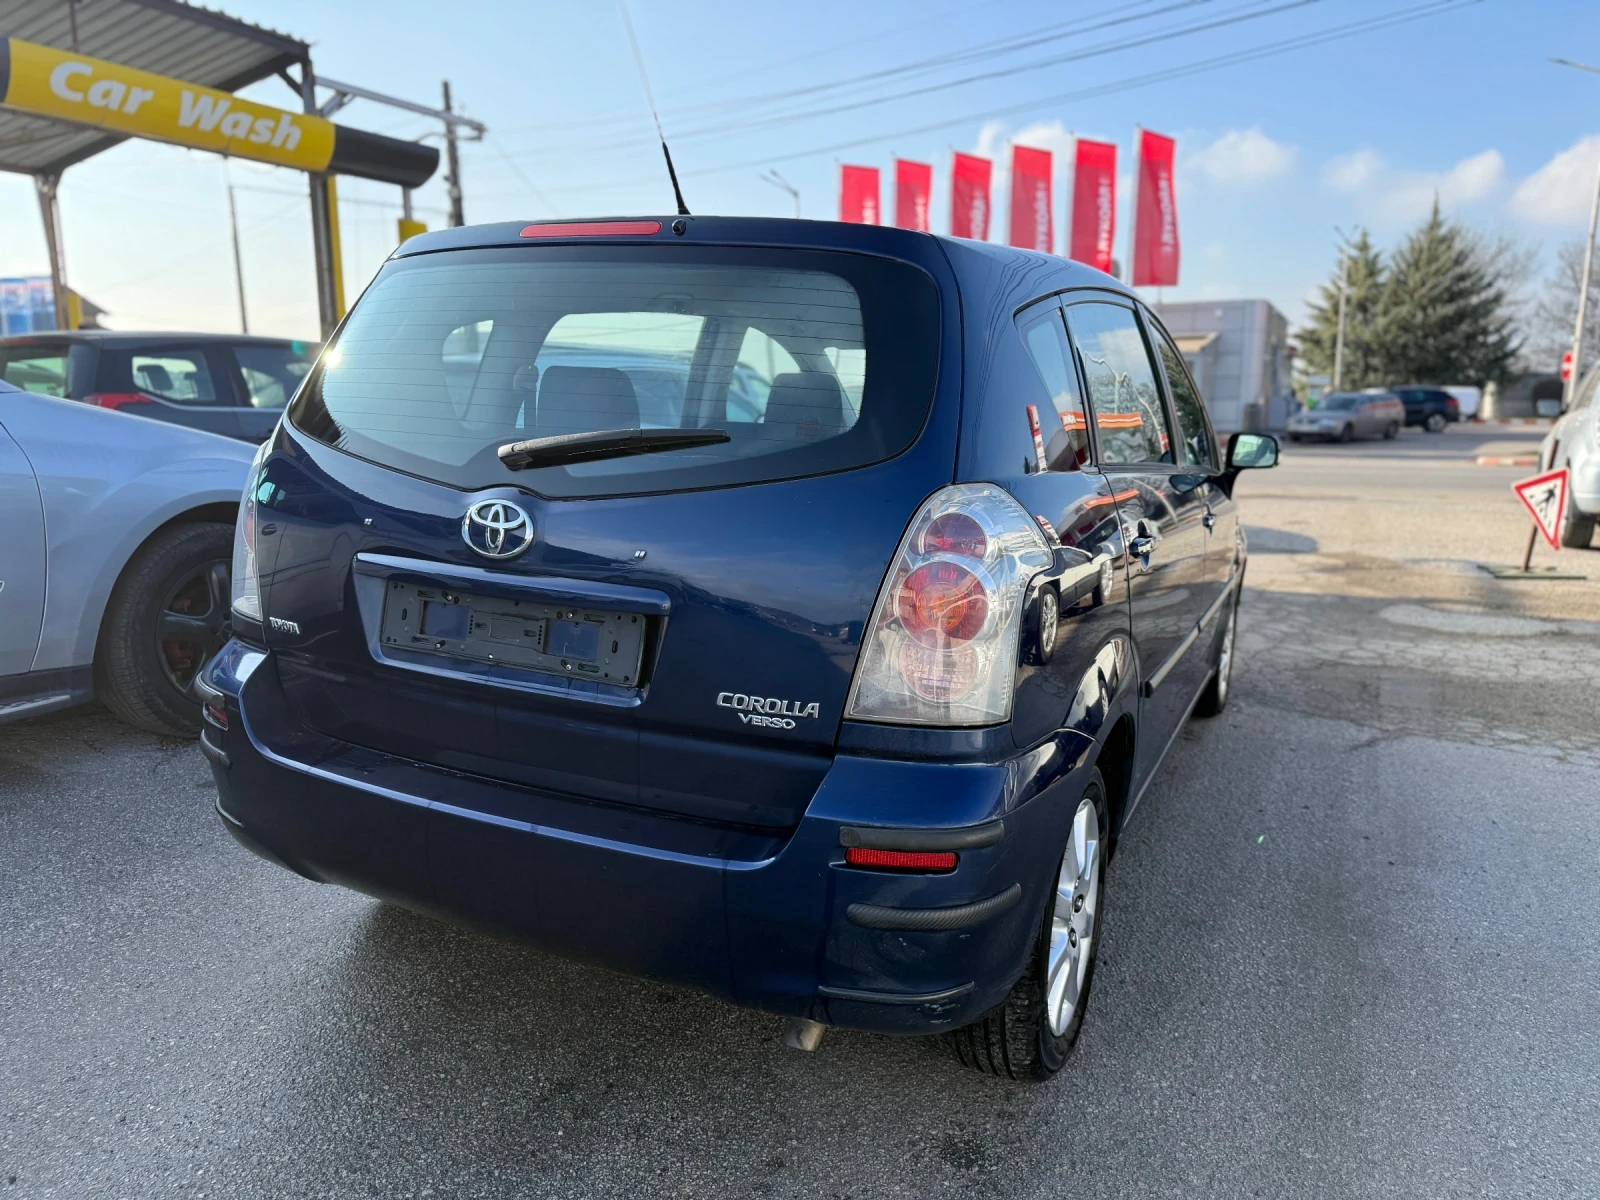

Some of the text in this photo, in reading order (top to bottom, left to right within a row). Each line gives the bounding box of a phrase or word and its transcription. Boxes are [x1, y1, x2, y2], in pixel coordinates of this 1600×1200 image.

[50, 61, 303, 150] Car Wash
[269, 616, 300, 635] TOYOTA
[716, 692, 820, 718] COROLLA
[737, 712, 796, 729] VERSO
